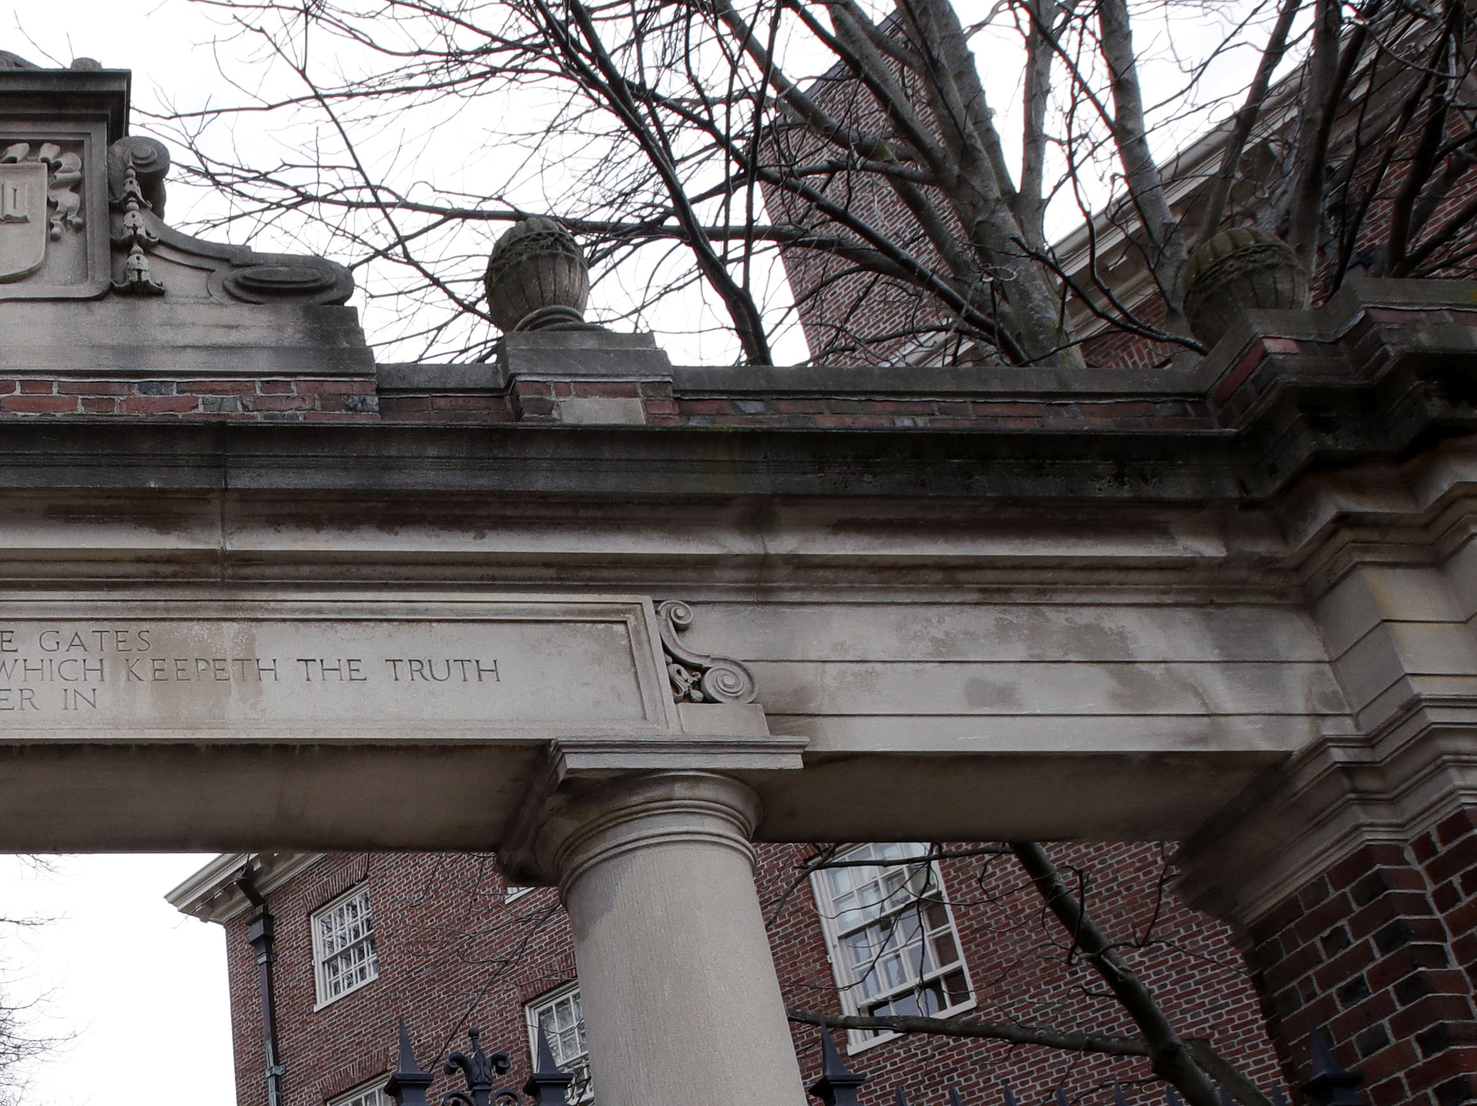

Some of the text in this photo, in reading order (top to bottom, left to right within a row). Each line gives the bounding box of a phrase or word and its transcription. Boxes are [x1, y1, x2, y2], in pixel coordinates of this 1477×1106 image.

[39, 630, 151, 652] GATES
[124, 658, 279, 682] KEEPETH
[296, 658, 368, 682] THE
[385, 658, 501, 682] TRUTH
[62, 687, 98, 710] IN
